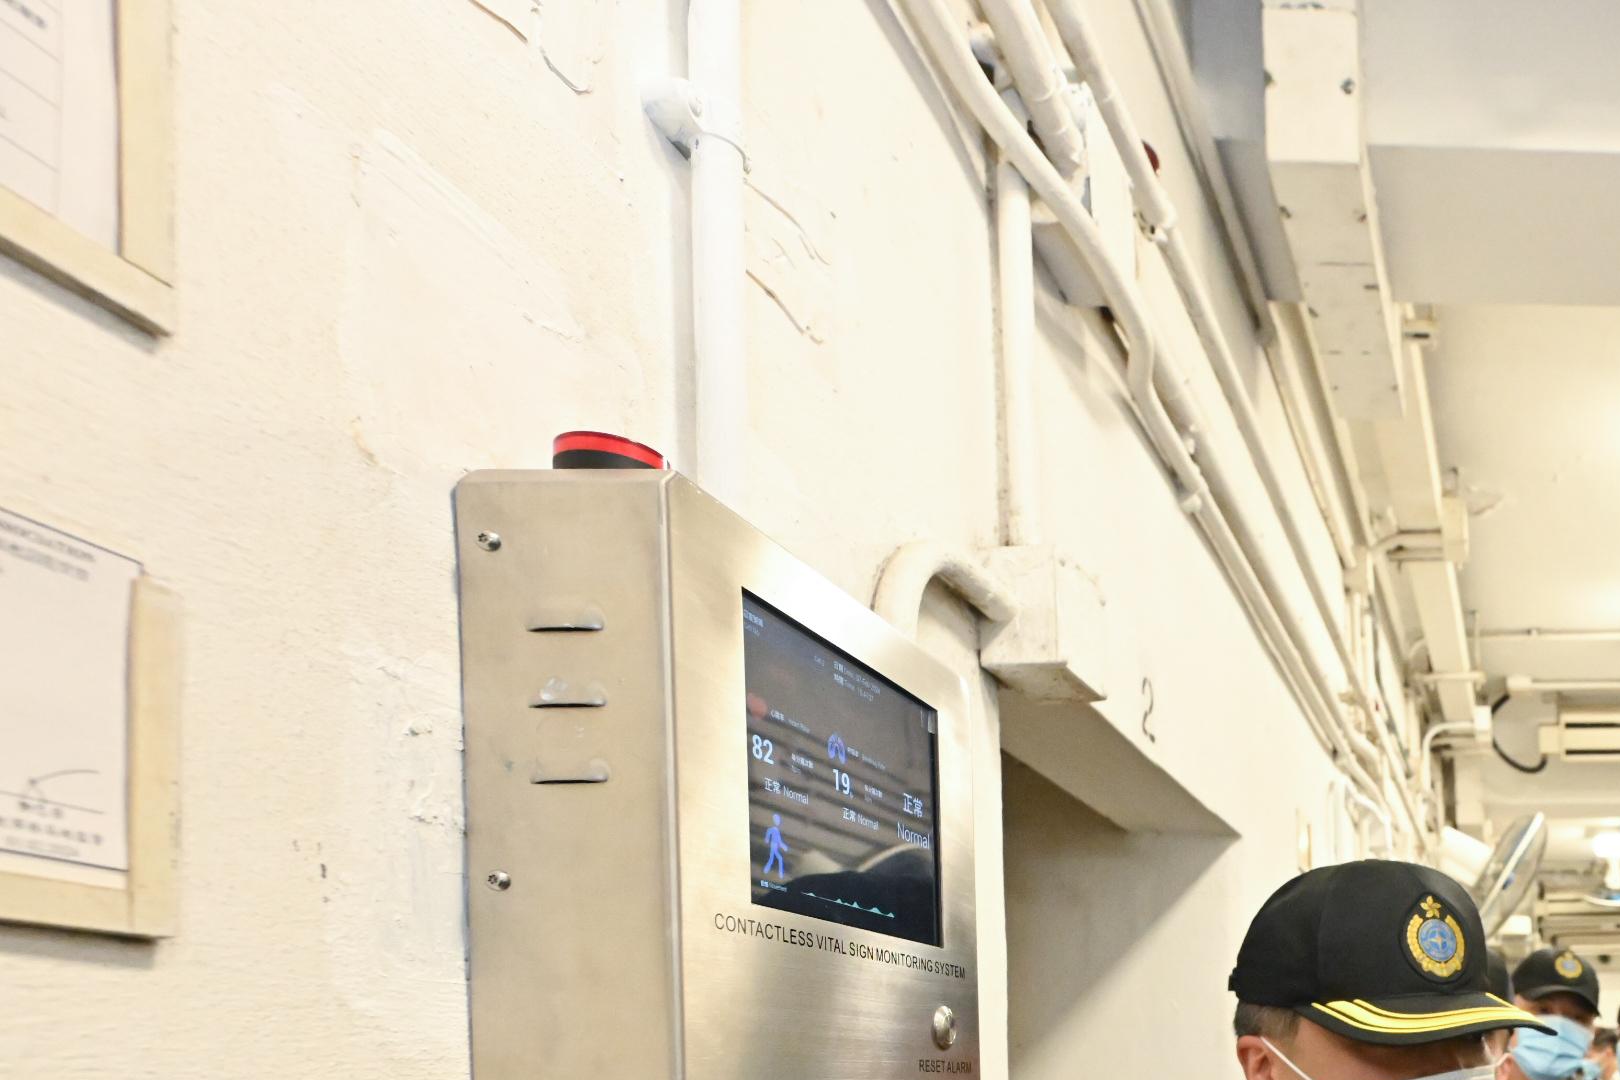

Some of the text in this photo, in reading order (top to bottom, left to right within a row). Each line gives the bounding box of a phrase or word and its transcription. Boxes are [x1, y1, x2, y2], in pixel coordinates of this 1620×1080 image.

[1141, 677, 1156, 743] 2
[752, 734, 775, 766] 82
[764, 777, 809, 806] 正常 Normal
[832, 769, 850, 796] 19
[842, 807, 879, 832] 正常 Normal
[902, 792, 923, 818] 正常
[897, 821, 930, 850] Normal
[714, 912, 966, 980] CONTACTLESS VITAL SIGN MONITORING SYSTEM
[918, 1059, 972, 1074] RESET ALARM
